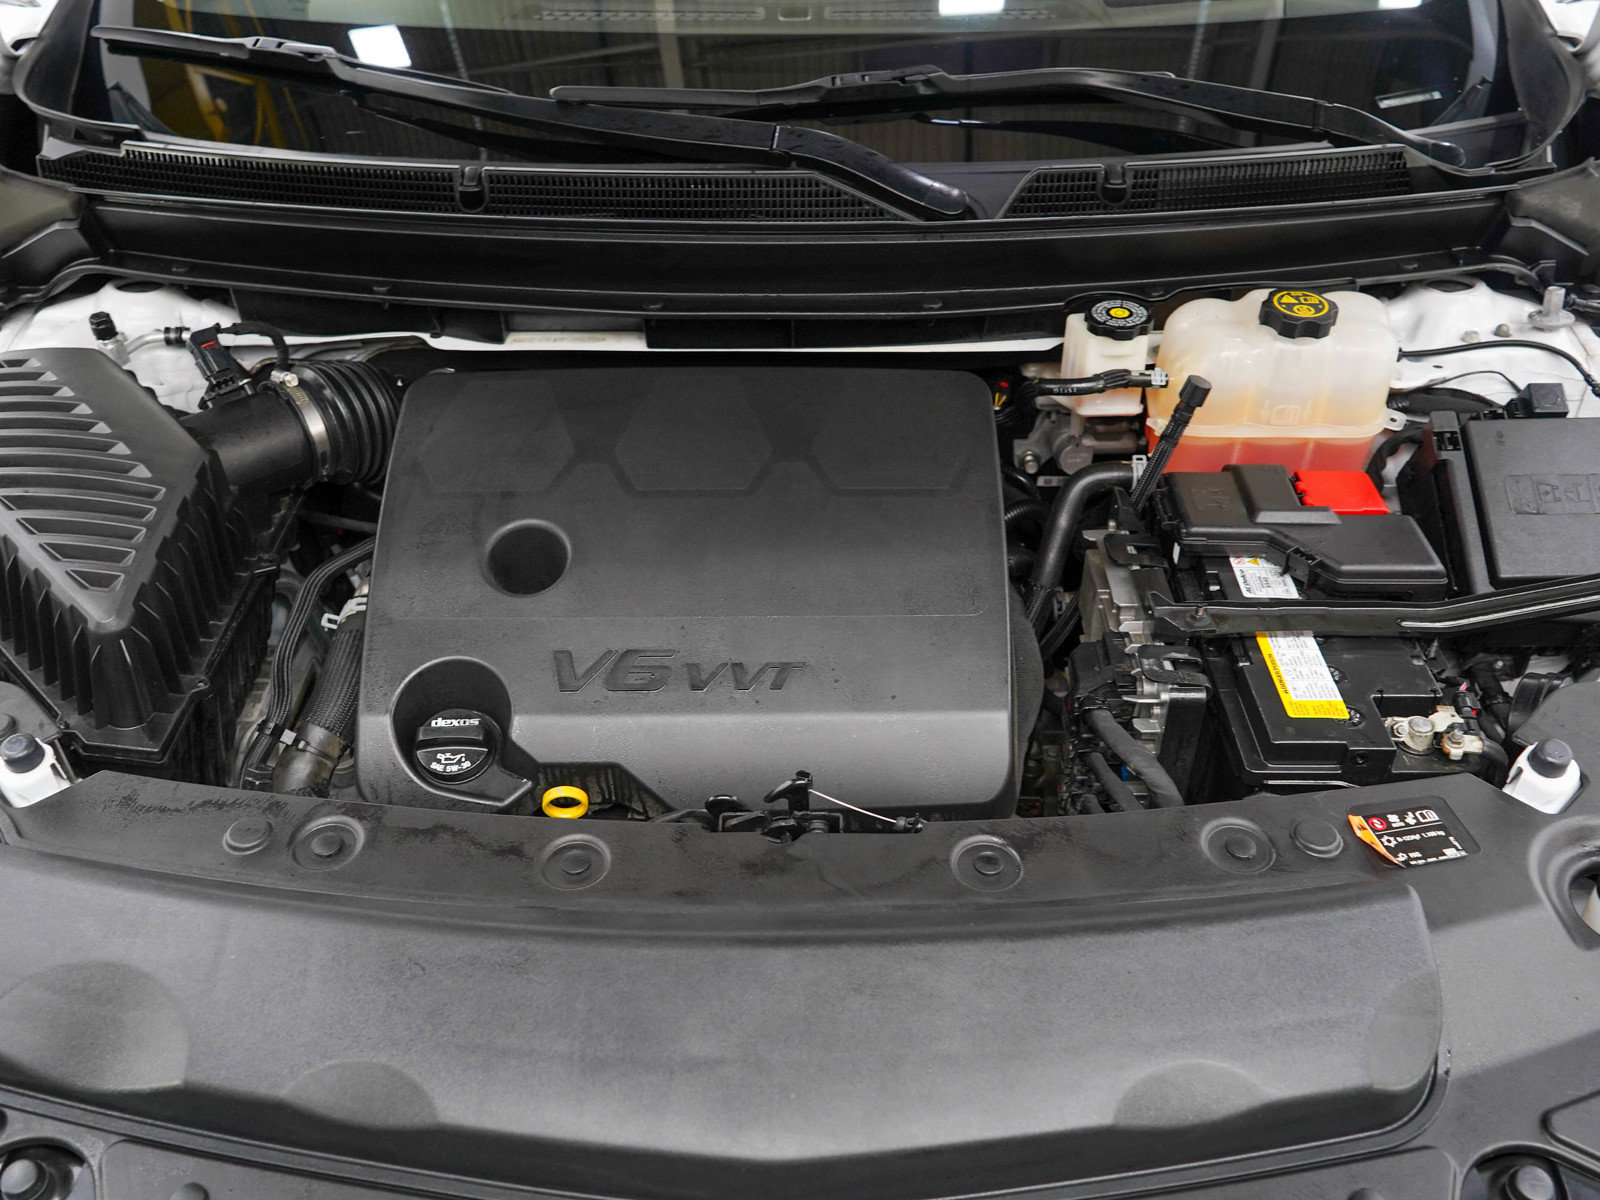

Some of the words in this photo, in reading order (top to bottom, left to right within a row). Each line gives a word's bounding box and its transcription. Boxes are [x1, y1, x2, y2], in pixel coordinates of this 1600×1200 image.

[552, 649, 678, 692] V6
[683, 661, 806, 691] VVT
[431, 717, 481, 727] dexos
[430, 762, 445, 772] SAE
[446, 761, 471, 772] 5W-30
